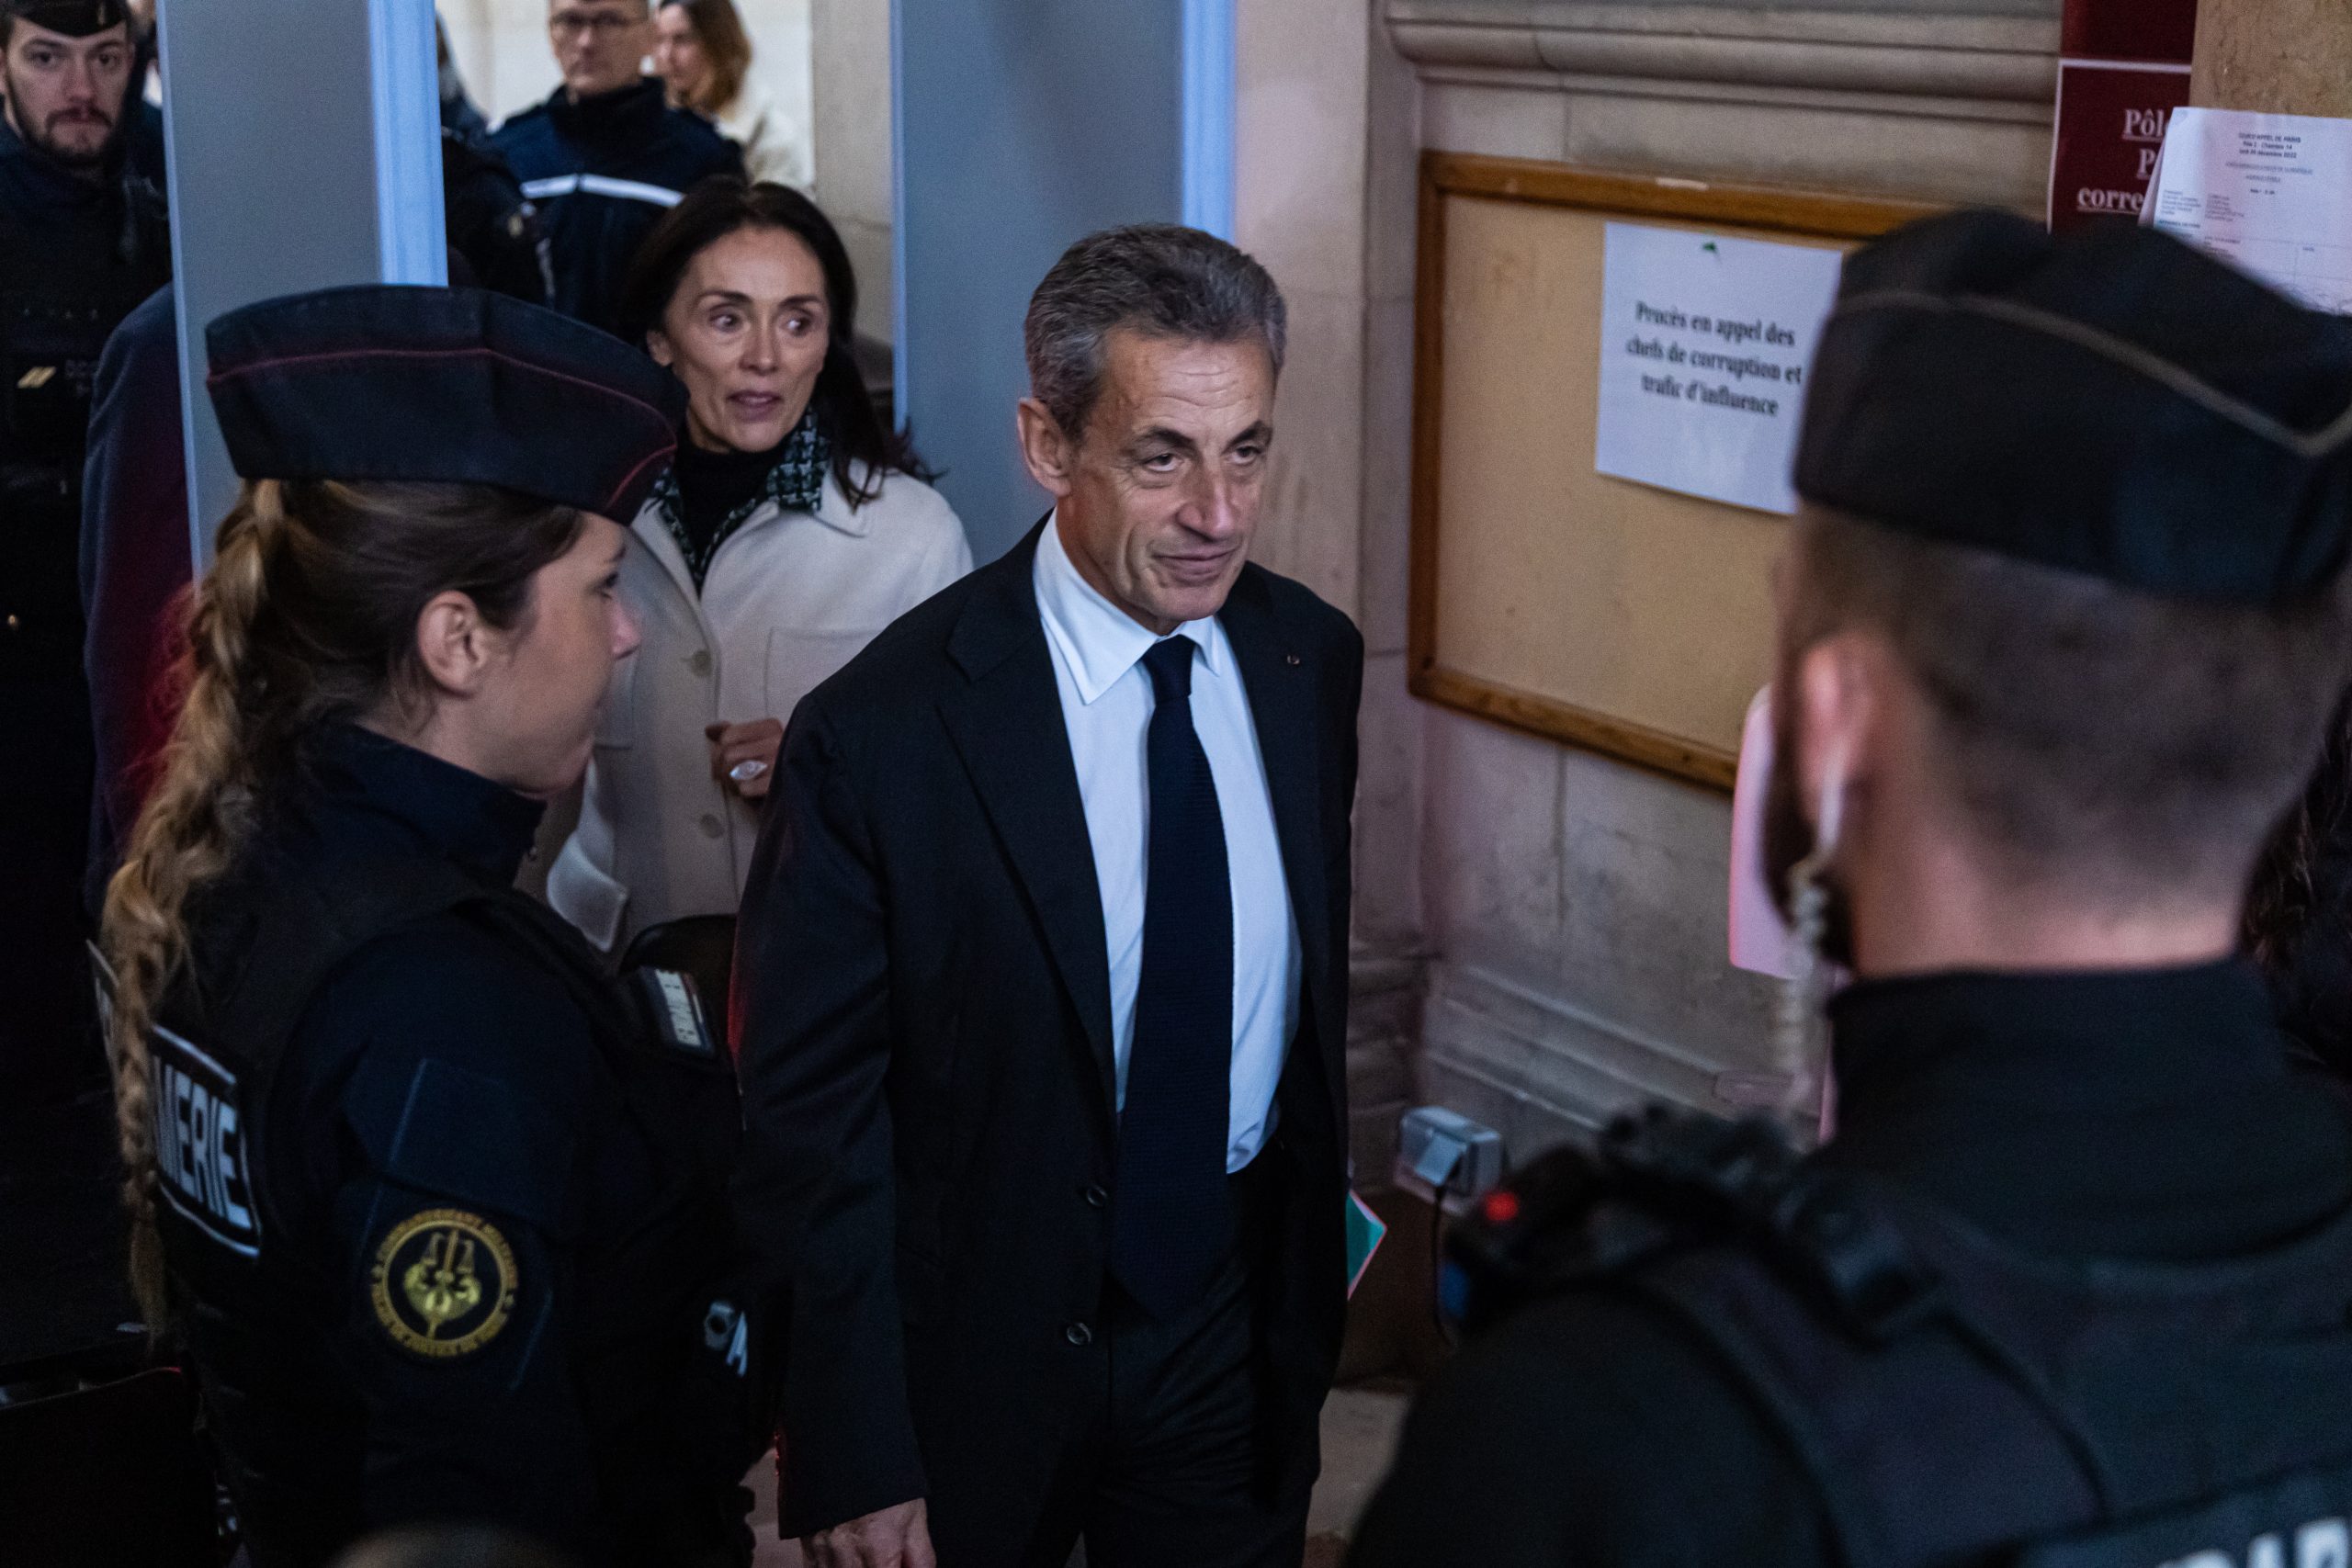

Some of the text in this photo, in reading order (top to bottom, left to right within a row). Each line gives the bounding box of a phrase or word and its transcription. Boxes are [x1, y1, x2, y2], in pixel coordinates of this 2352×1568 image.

[2123, 108, 2167, 138] Pôl
[1635, 299, 1795, 347] Procès en appel des
[1625, 333, 1802, 385] chefs de corruption et
[1641, 373, 1682, 399] trafic
